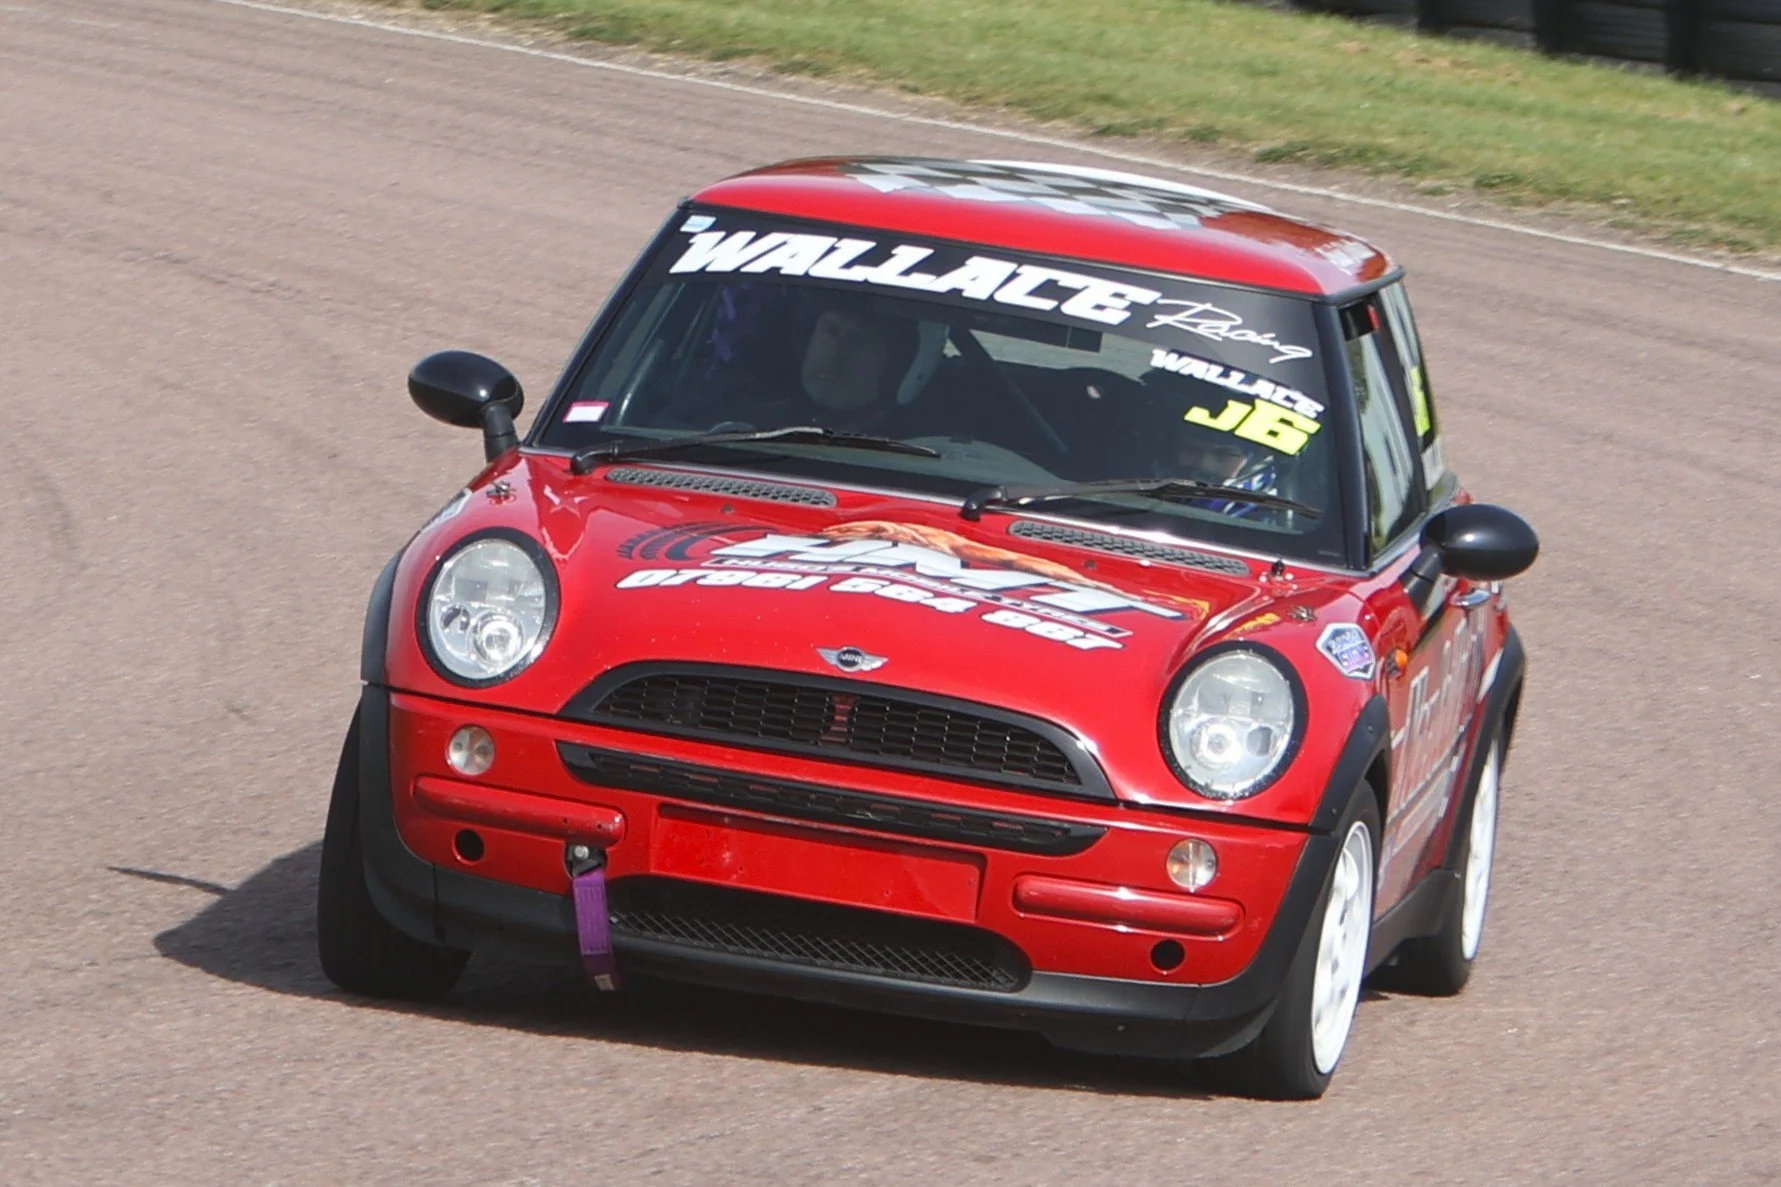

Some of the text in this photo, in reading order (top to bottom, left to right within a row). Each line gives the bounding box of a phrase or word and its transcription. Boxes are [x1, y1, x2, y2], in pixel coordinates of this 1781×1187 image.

[669, 231, 1313, 364] WALLACE Racing
[1150, 349, 1325, 418] WALLACE
[1184, 399, 1322, 456] J6
